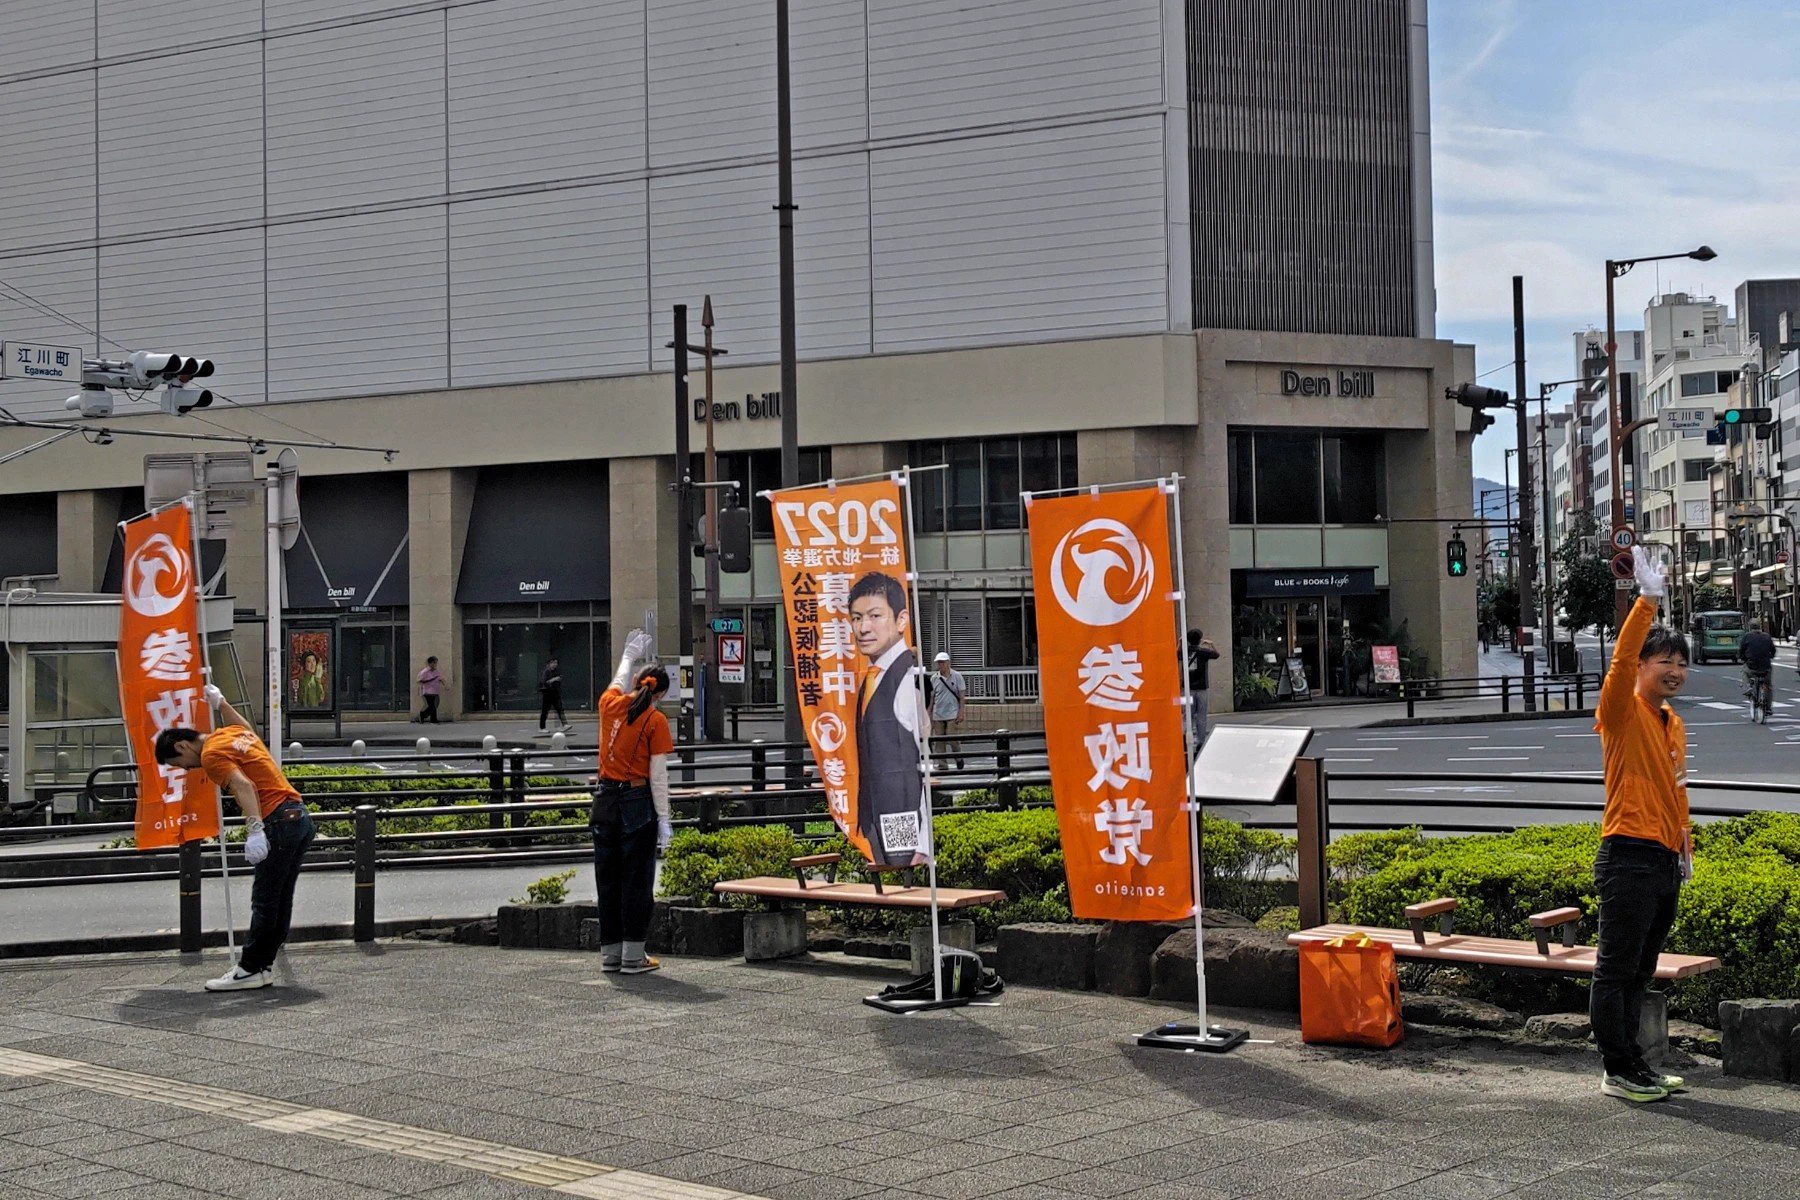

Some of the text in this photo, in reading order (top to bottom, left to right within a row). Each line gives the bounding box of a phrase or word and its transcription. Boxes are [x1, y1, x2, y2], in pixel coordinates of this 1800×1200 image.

[18, 348, 70, 367] 江川町
[25, 365, 63, 376] Egawacho
[1281, 369, 1375, 397] Den bill
[693, 392, 782, 421] Den bill
[1667, 411, 1704, 421] 江川町
[1616, 533, 1631, 545] 40
[519, 581, 550, 591] Den bill
[1303, 578, 1329, 586] BOOKS
[327, 587, 356, 596] Den bill
[723, 621, 732, 630] 27
